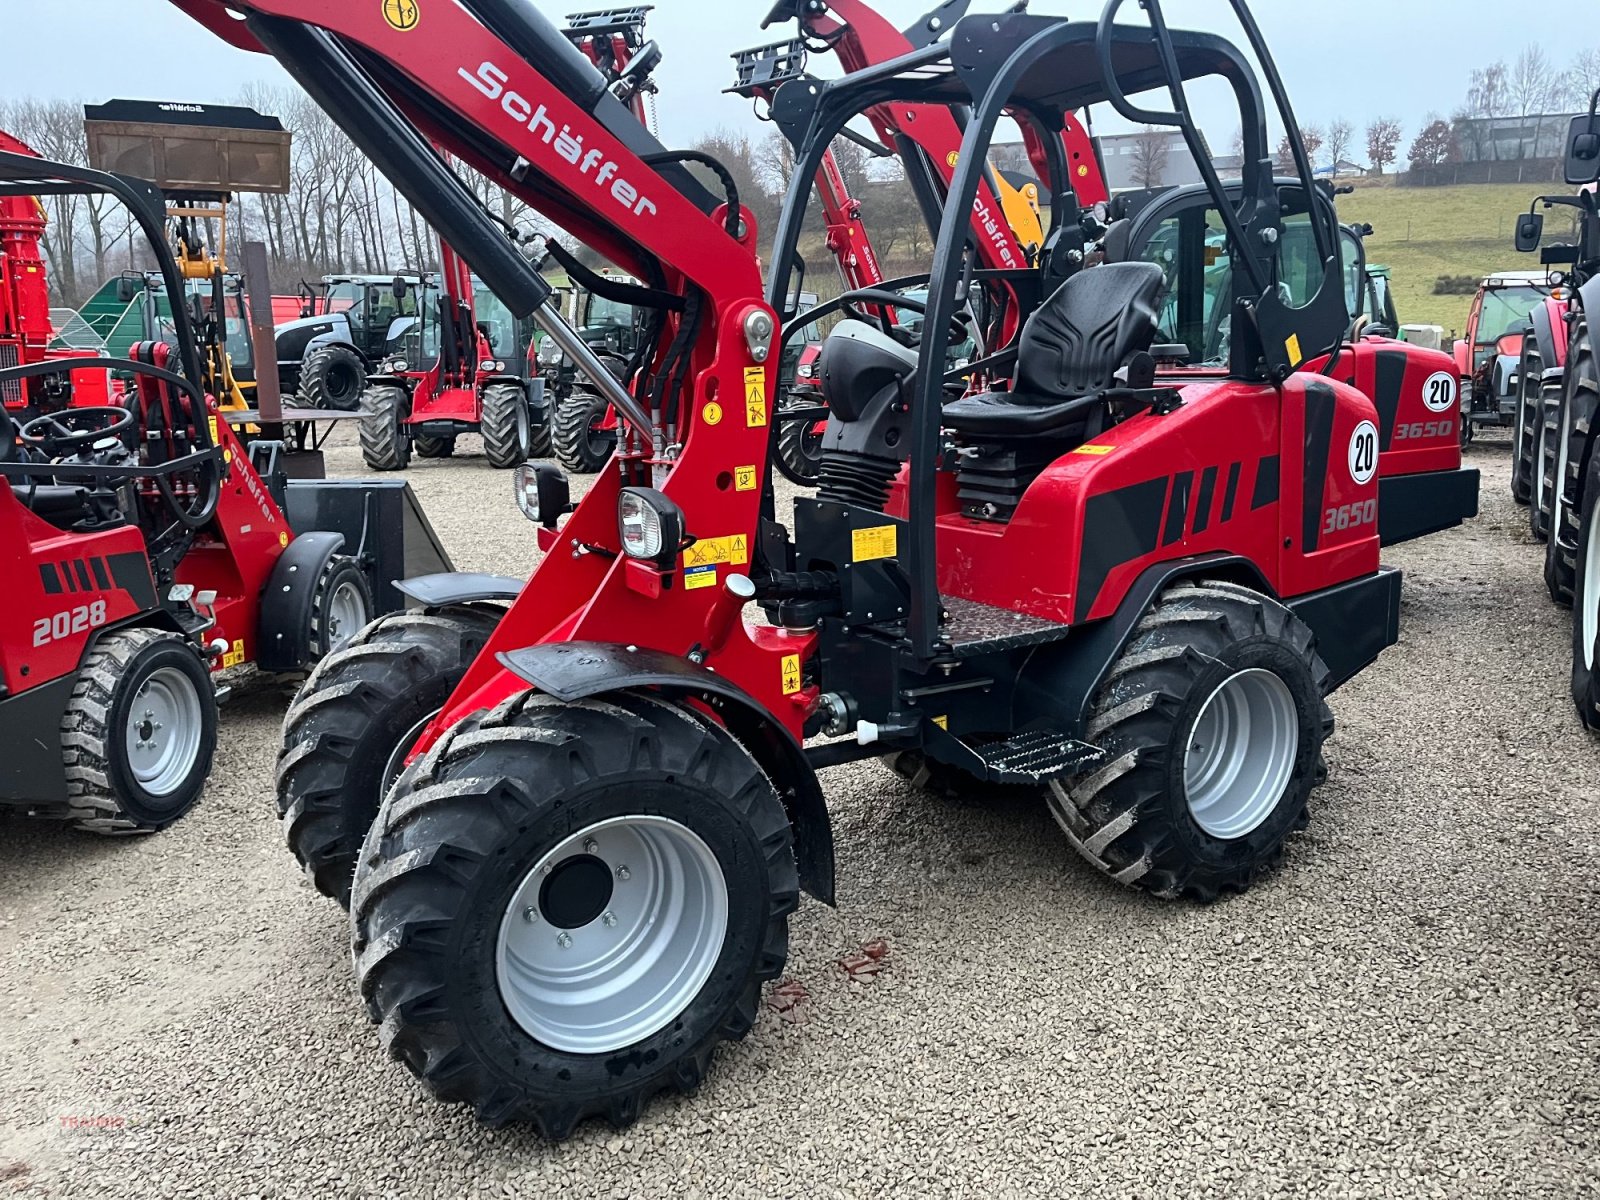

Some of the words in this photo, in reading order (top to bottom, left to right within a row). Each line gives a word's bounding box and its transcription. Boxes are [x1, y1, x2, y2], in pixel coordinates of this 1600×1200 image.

[457, 61, 657, 216] Schäffer
[973, 190, 1017, 269] chäffer
[1430, 380, 1450, 404] 20
[1394, 420, 1453, 440] 3650
[1355, 433, 1374, 473] 20
[230, 443, 275, 523] Schäffer
[1323, 498, 1377, 534] 3650
[33, 600, 106, 648] 2028
